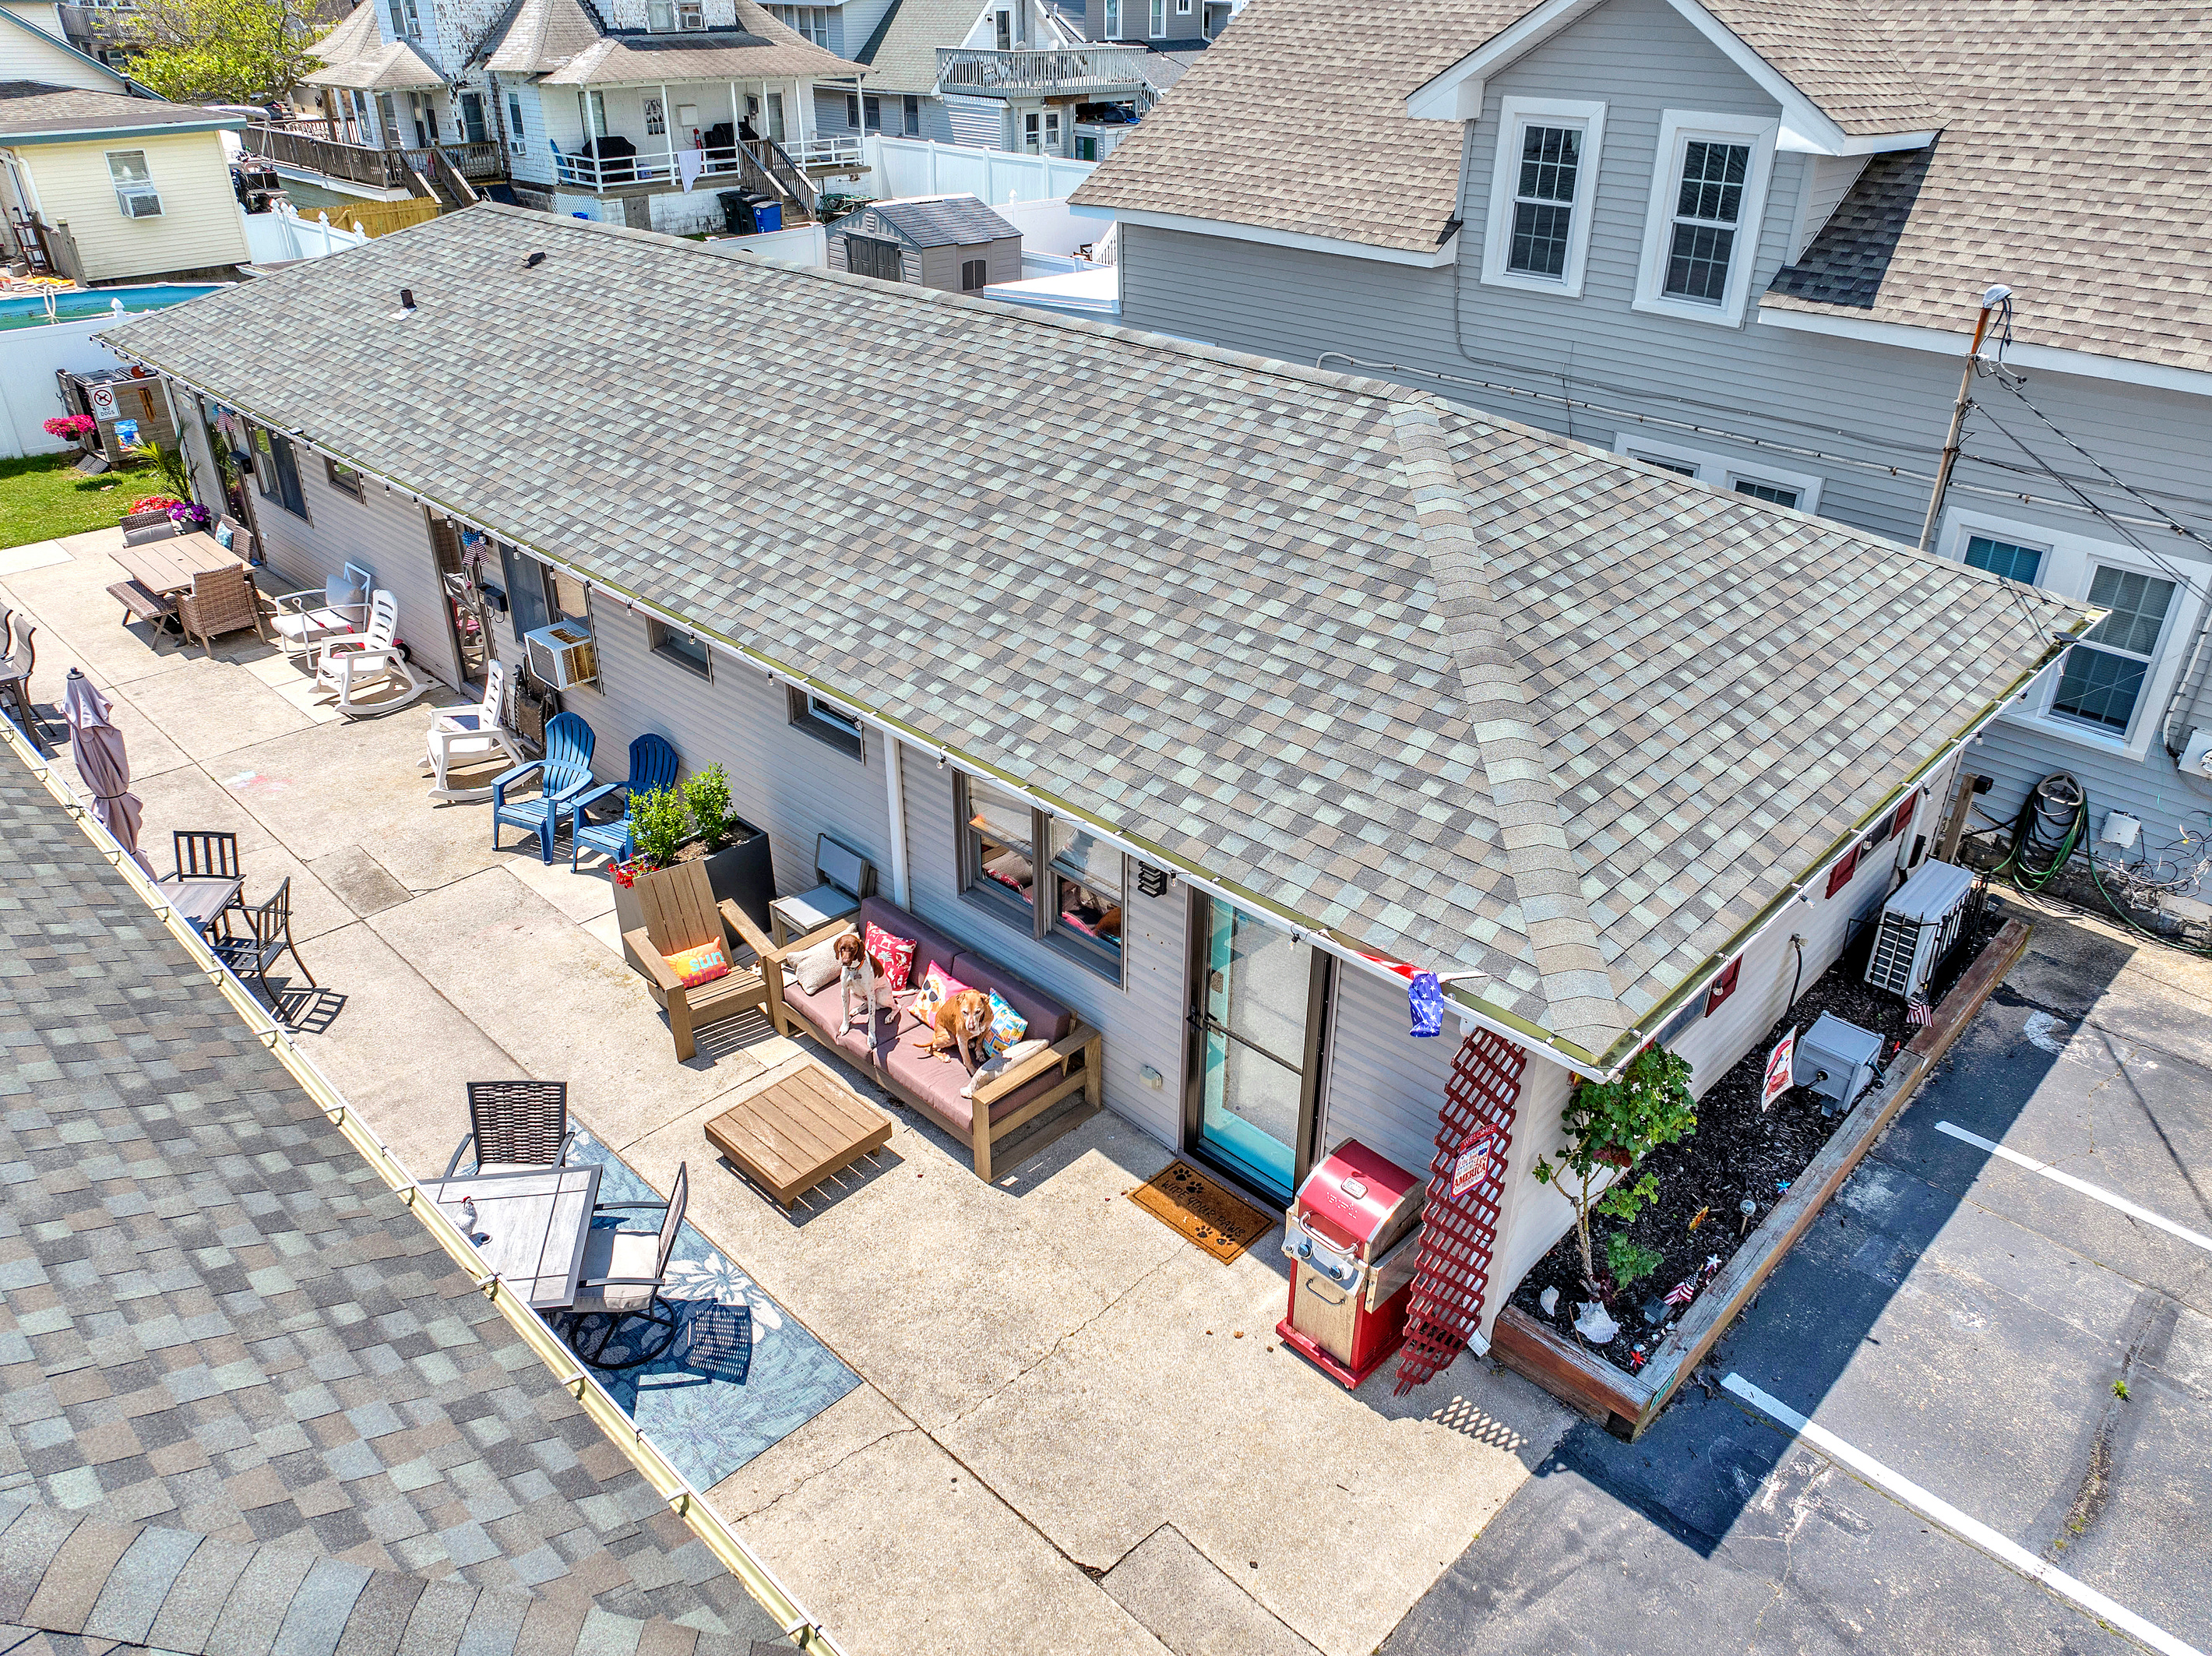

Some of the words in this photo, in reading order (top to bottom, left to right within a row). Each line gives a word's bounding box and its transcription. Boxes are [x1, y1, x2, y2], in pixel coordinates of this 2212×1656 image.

[689, 951, 725, 972] sun
[1463, 1124, 1495, 1147] WELCOME
[1454, 1162, 1485, 1188] AMERICA
[1161, 1181, 1189, 1198] WIPE
[1188, 1196, 1216, 1219] YOUR
[1215, 1215, 1245, 1238] PAWS
